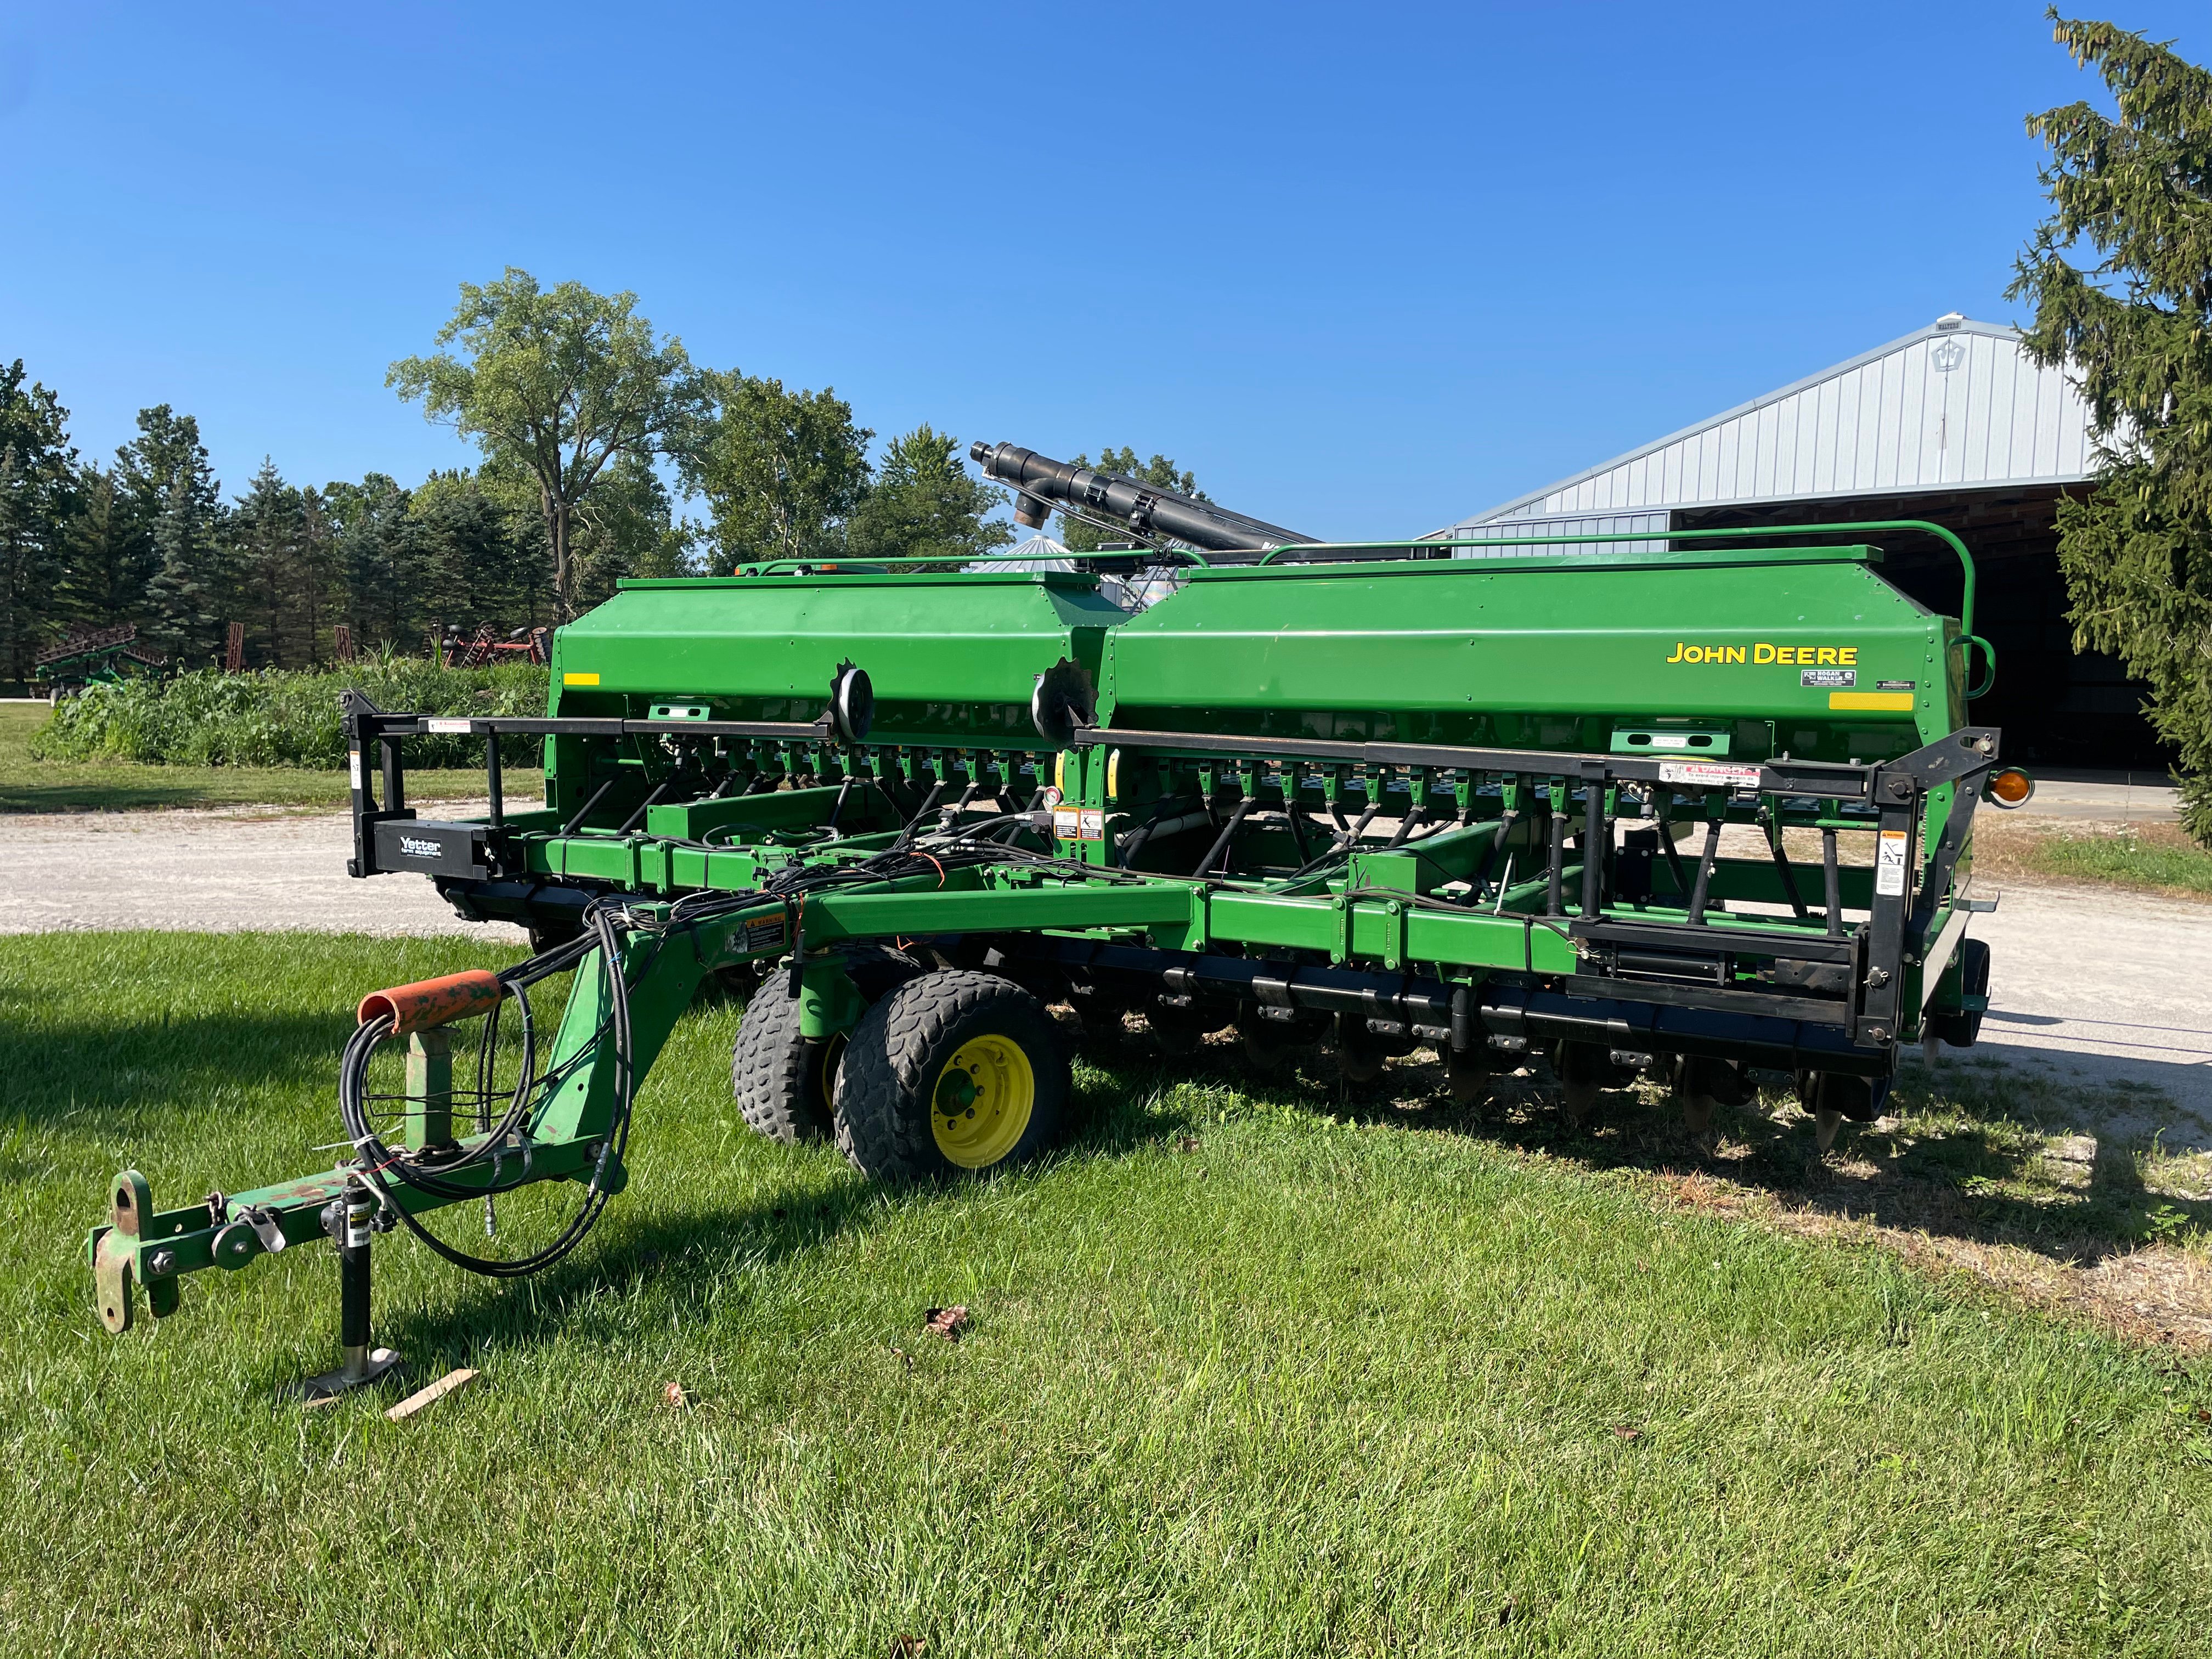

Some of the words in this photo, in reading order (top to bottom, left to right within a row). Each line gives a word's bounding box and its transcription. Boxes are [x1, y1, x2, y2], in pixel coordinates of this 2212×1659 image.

[1666, 641, 1747, 664] JOHN
[1752, 642, 1858, 665] DEERE
[400, 837, 441, 851] Yetter
[758, 916, 782, 925] WARNING
